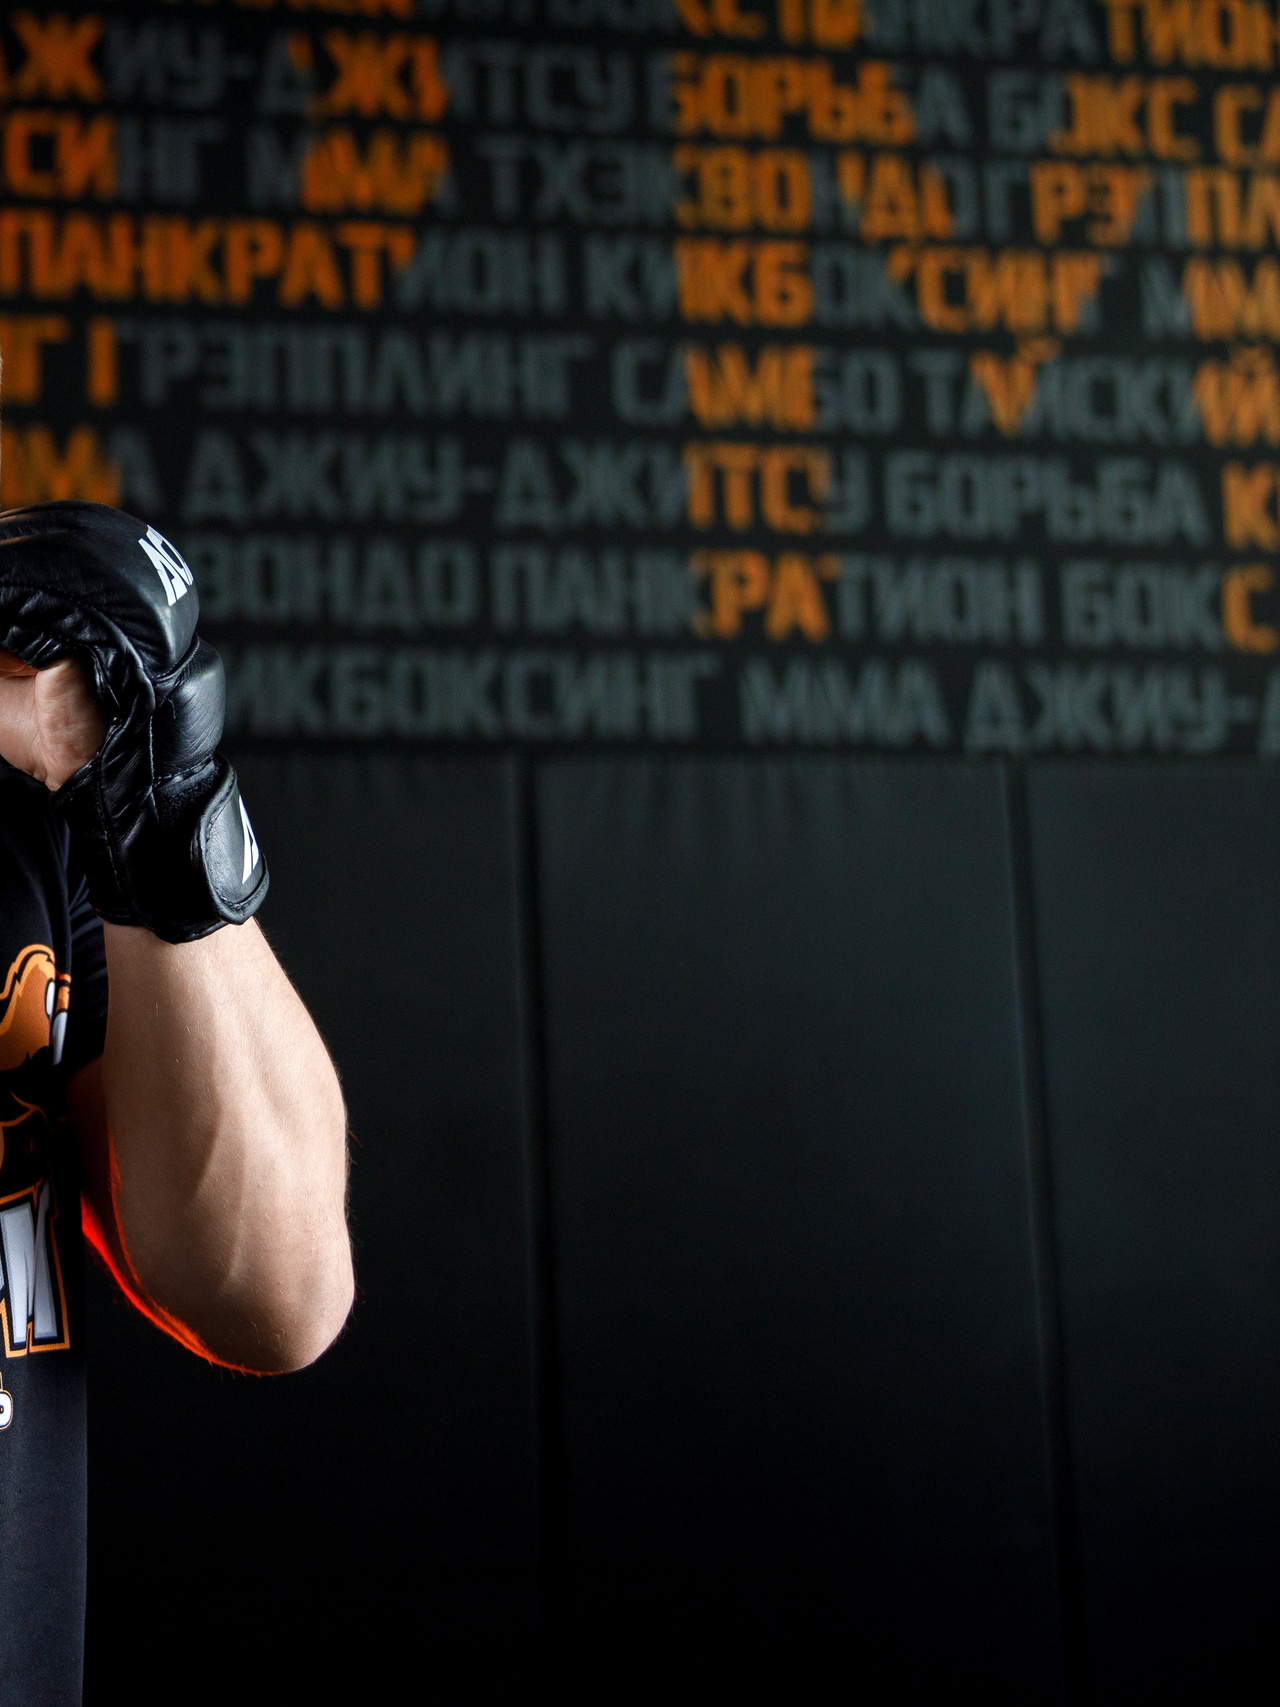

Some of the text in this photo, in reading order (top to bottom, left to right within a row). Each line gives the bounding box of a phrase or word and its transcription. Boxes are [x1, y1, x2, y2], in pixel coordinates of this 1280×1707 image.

[644, 48, 972, 150] БОРЬБА
[986, 68, 1202, 163] БОКС
[246, 124, 462, 216] ММА
[610, 333, 904, 436] САМБО
[883, 444, 1210, 548] БОРЬБА
[1060, 556, 1280, 655] БОКС
[740, 655, 950, 748] ММА
